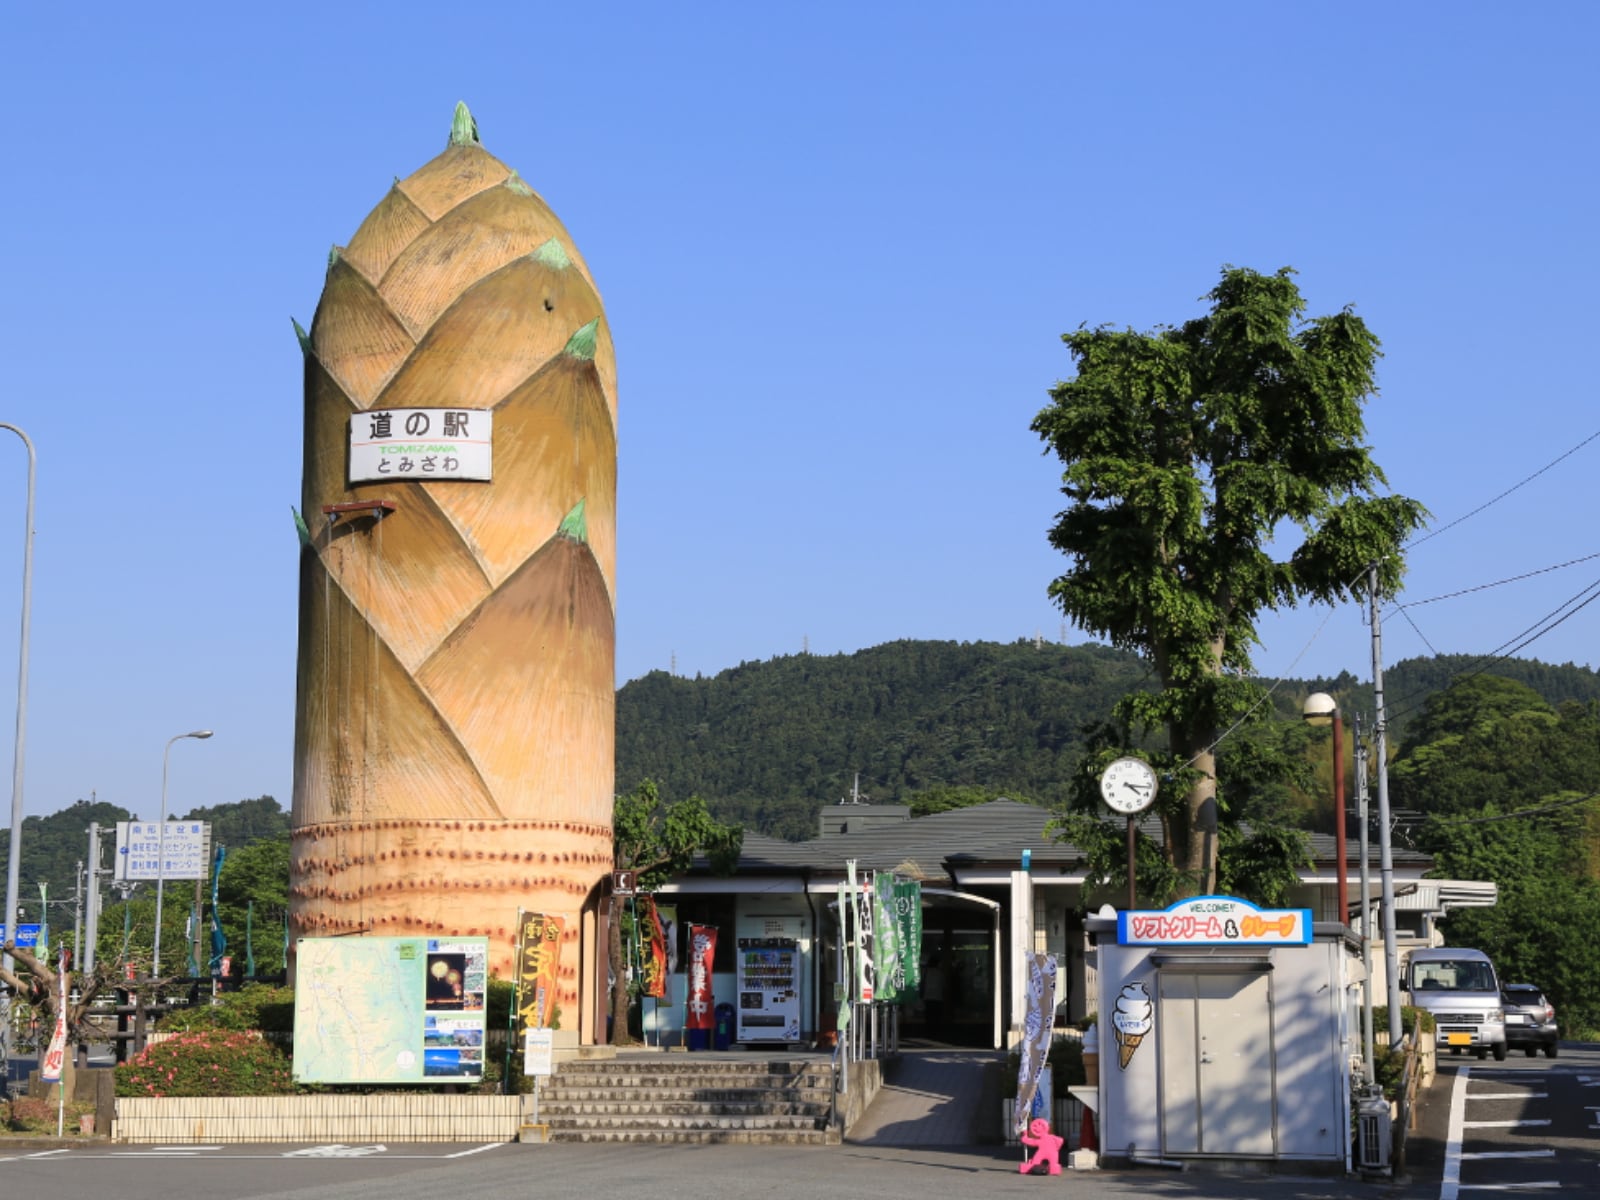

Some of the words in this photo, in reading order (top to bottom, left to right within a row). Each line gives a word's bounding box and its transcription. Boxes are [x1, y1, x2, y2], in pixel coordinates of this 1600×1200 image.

[369, 411, 469, 439] 道の駅
[378, 445, 458, 454] TOMIZAWA
[378, 455, 459, 473] とみざわ
[1132, 916, 1222, 939] ソフトクリーム
[1224, 919, 1239, 939] &
[1240, 914, 1296, 938] クレープ
[690, 934, 712, 1022] 営業中
